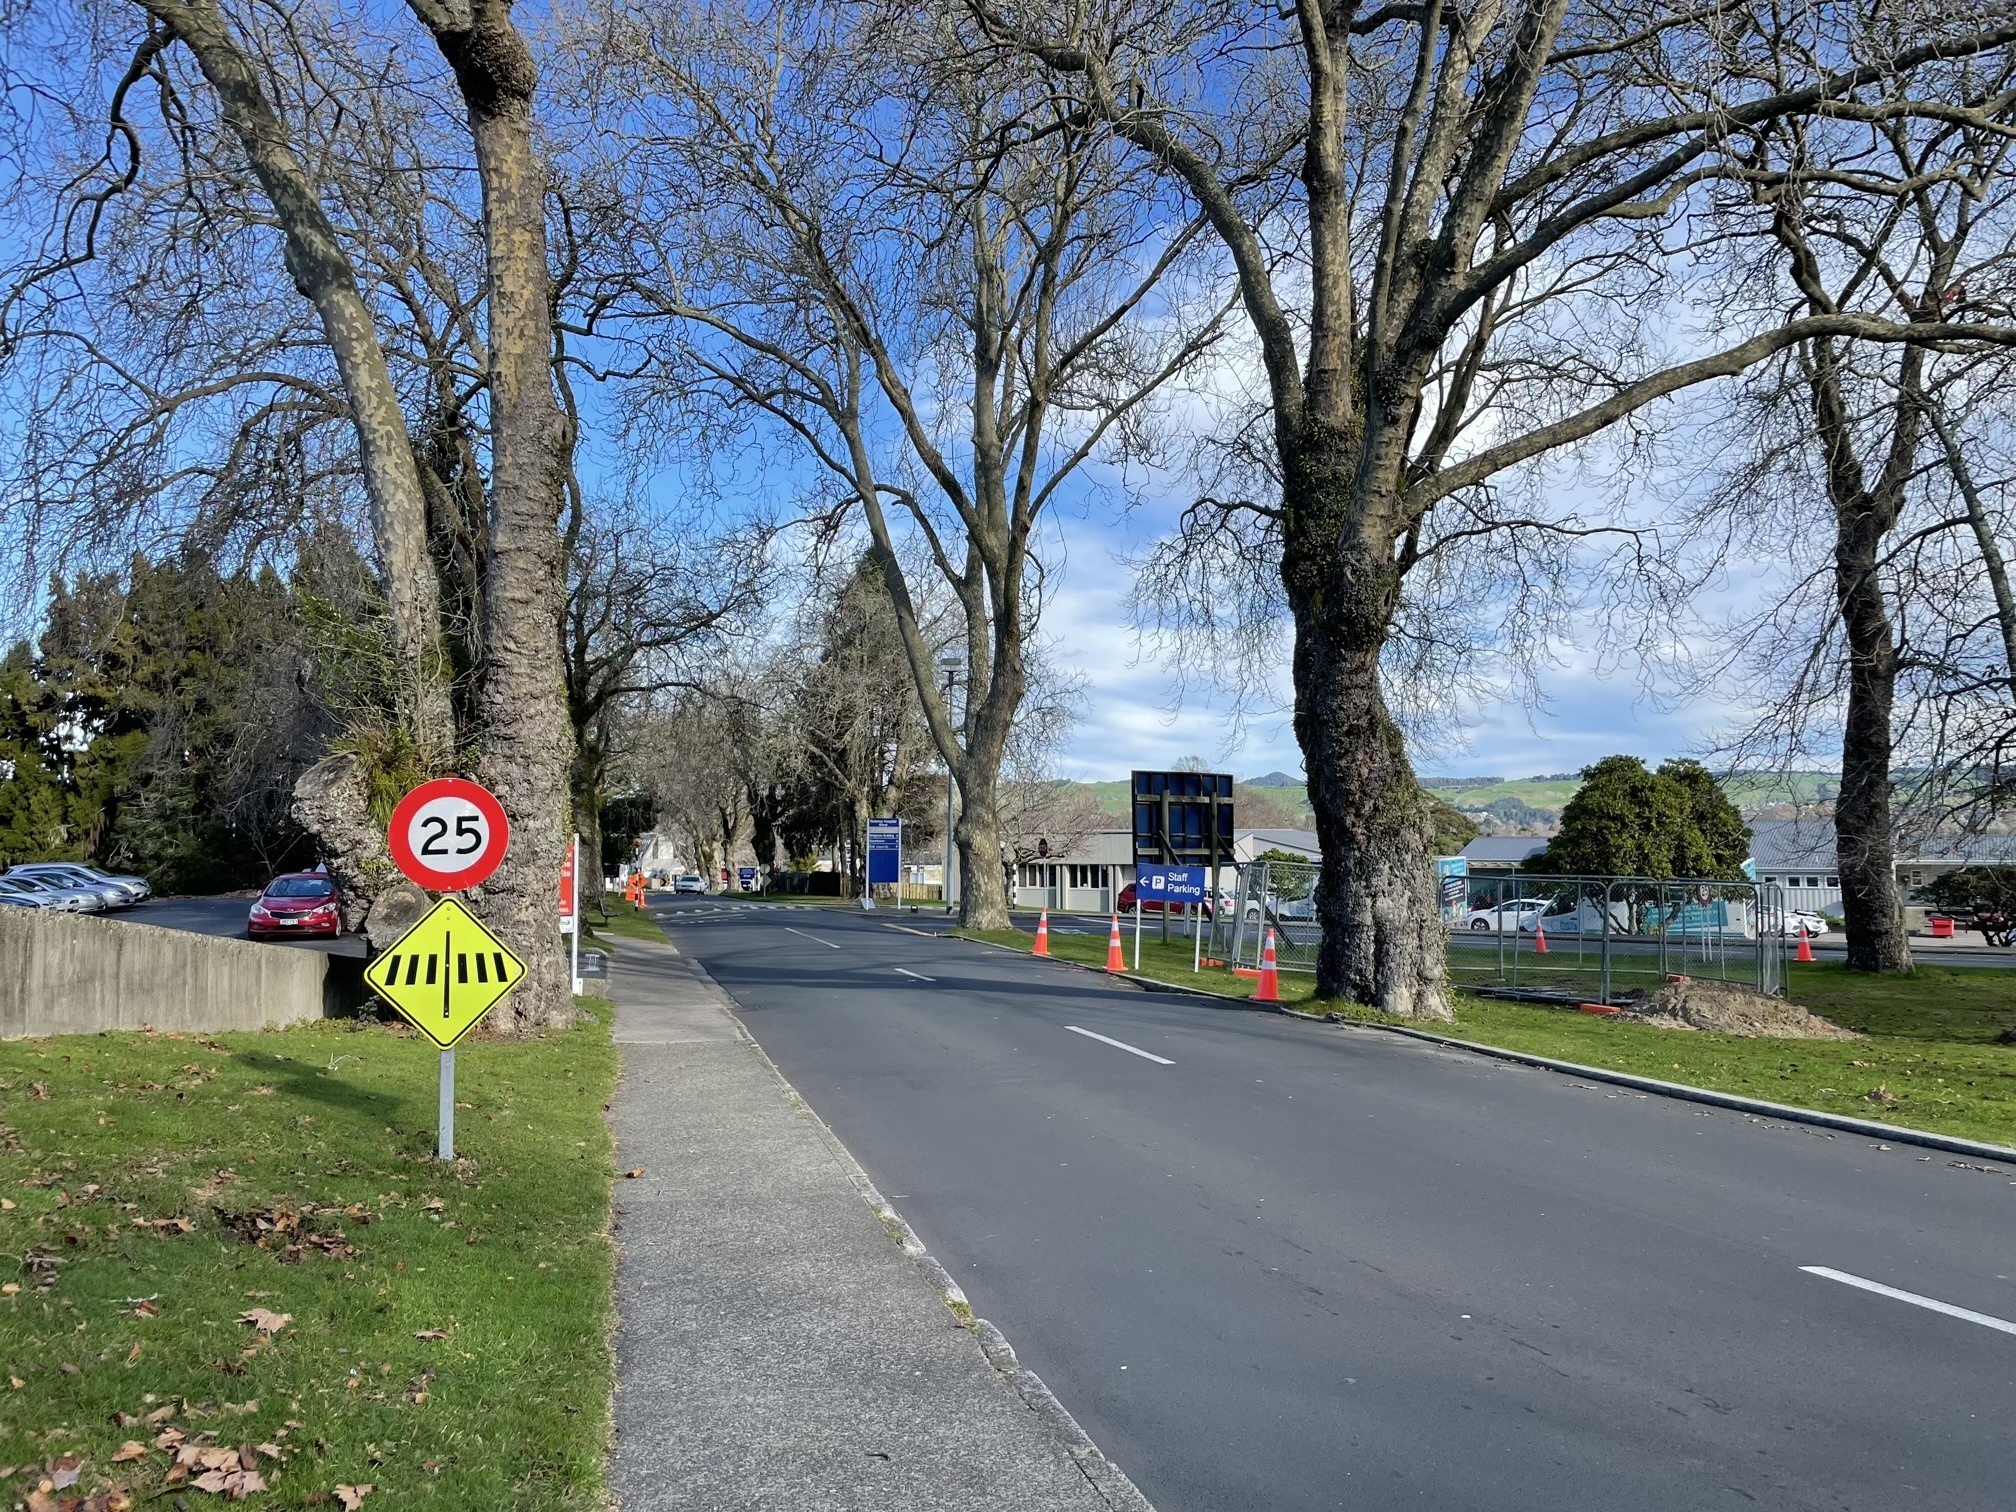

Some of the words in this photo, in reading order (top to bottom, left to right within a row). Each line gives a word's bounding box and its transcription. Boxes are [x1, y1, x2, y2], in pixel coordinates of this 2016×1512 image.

[421, 815, 482, 855] 25
[1155, 878, 1161, 886] P
[1168, 872, 1188, 881] Staff
[1167, 883, 1200, 896] Parking
